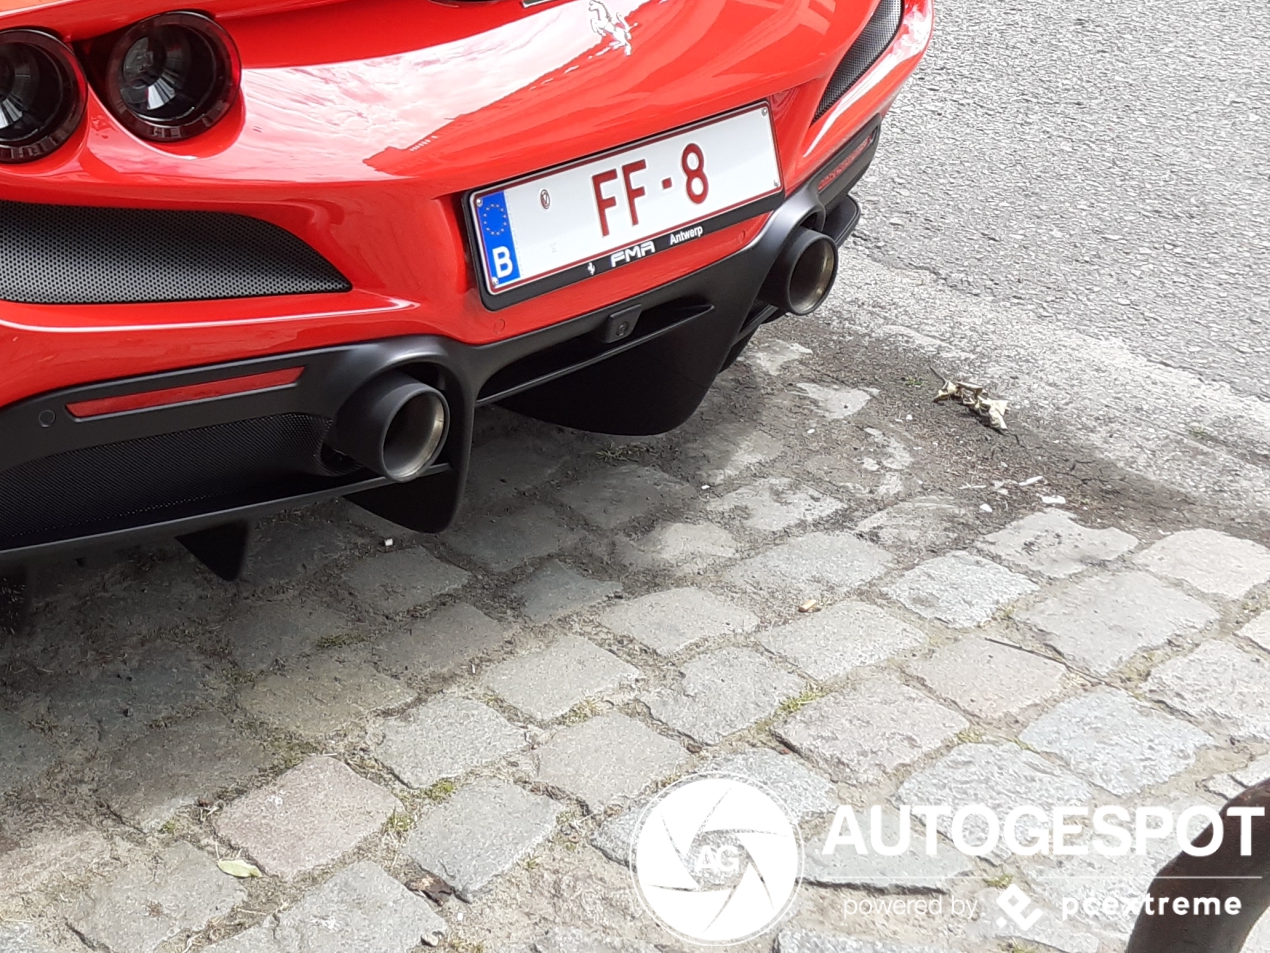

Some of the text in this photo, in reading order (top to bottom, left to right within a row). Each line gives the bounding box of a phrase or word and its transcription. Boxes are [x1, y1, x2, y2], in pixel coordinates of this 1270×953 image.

[492, 246, 514, 279] B
[610, 226, 703, 268] FMA Antwerp
